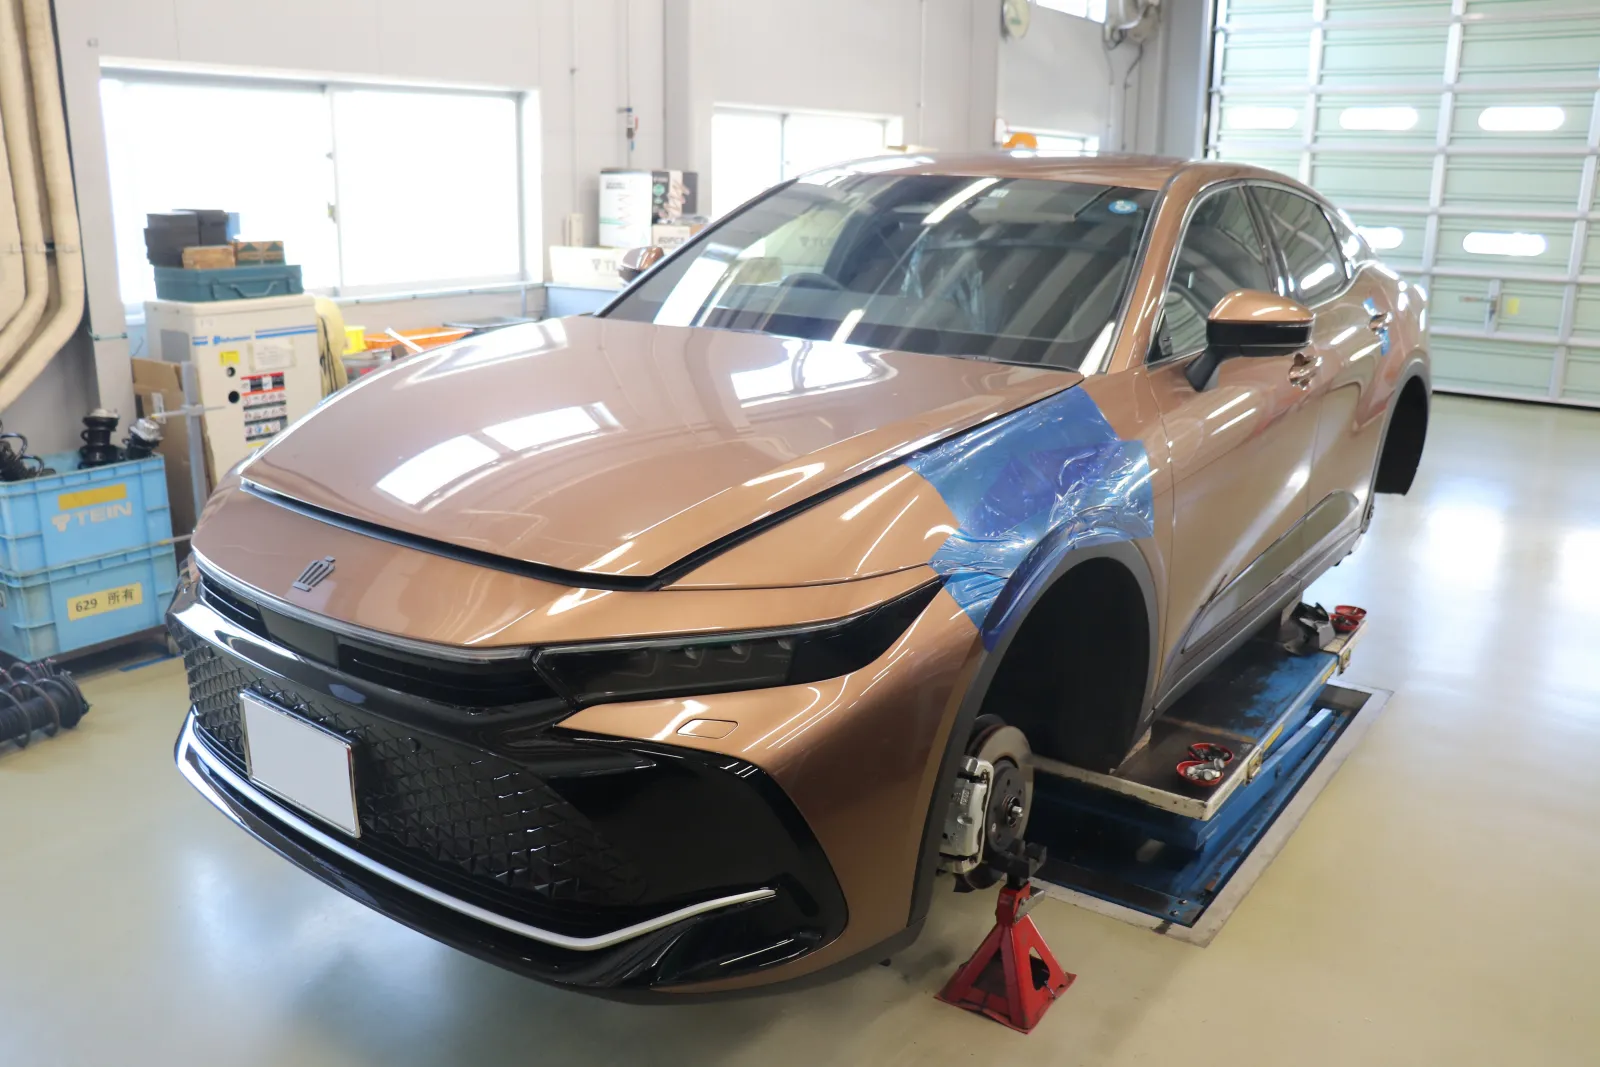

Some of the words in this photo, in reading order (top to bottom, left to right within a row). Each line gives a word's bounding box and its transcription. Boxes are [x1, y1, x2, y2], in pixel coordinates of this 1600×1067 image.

[74, 501, 132, 526] TEIN
[75, 598, 98, 612] 629
[107, 588, 135, 605] 所有
